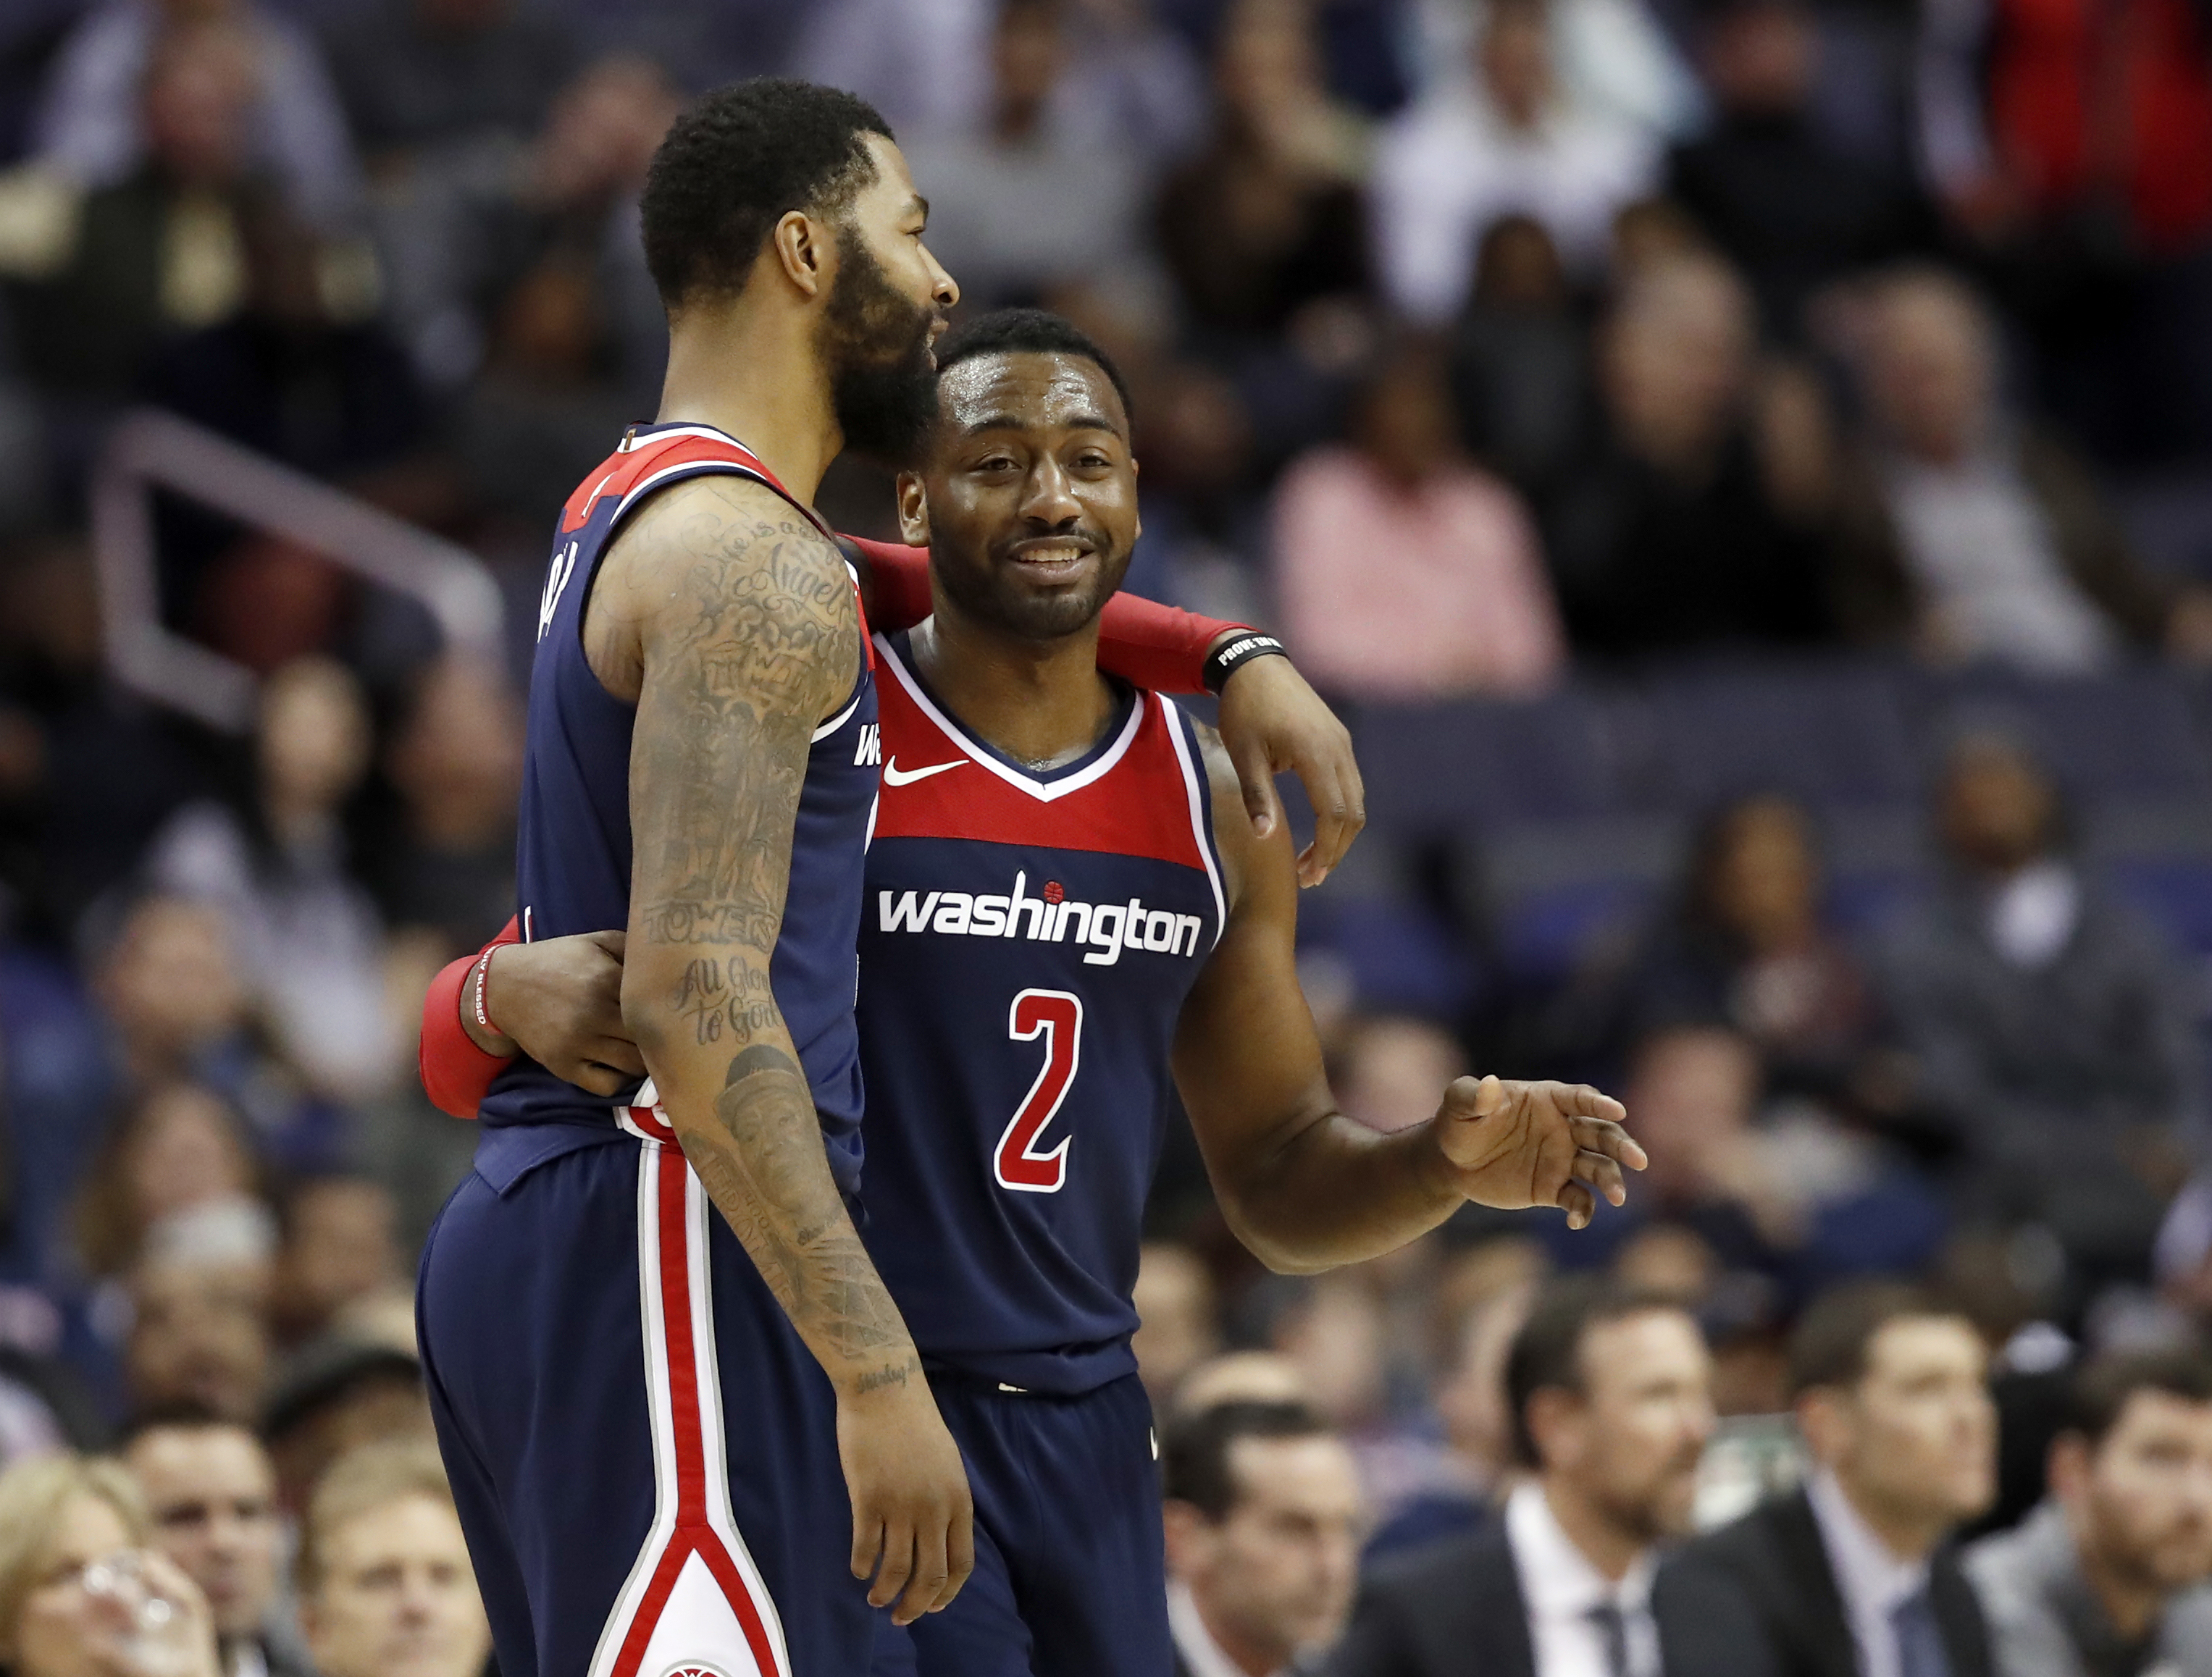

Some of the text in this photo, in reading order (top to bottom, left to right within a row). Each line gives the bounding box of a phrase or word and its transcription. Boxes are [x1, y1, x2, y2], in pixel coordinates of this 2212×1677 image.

[1218, 639, 1257, 666] PROVE
[878, 869, 1202, 966] washington
[475, 972, 487, 1025] BLESSED
[668, 958, 725, 1012] All
[729, 994, 786, 1045] God
[993, 987, 1084, 1193] 2
